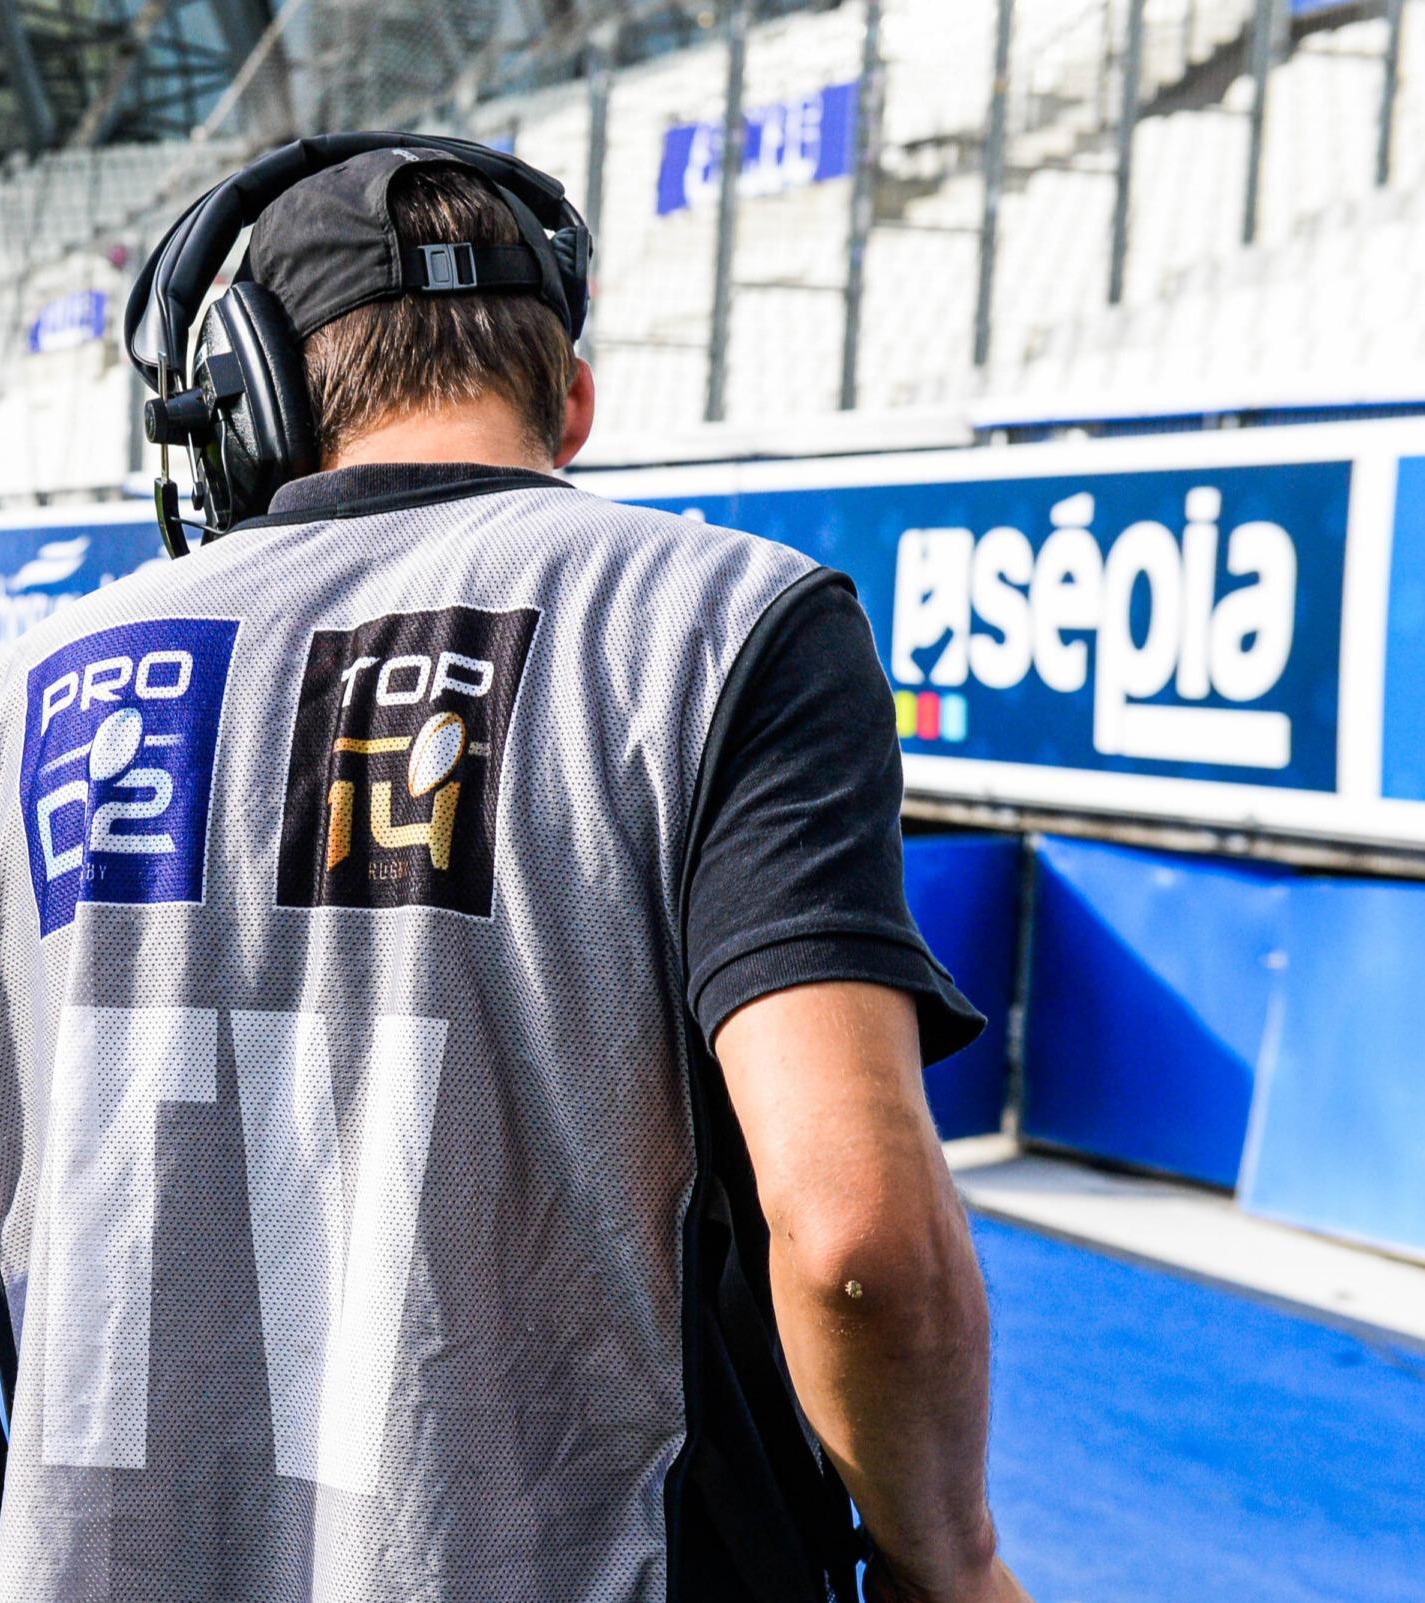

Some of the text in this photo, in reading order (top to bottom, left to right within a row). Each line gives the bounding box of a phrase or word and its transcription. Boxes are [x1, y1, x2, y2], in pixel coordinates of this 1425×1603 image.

[969, 486, 1297, 769] sépia
[40, 650, 194, 737] PRO
[340, 651, 495, 708] TOP
[327, 779, 461, 872] 14
